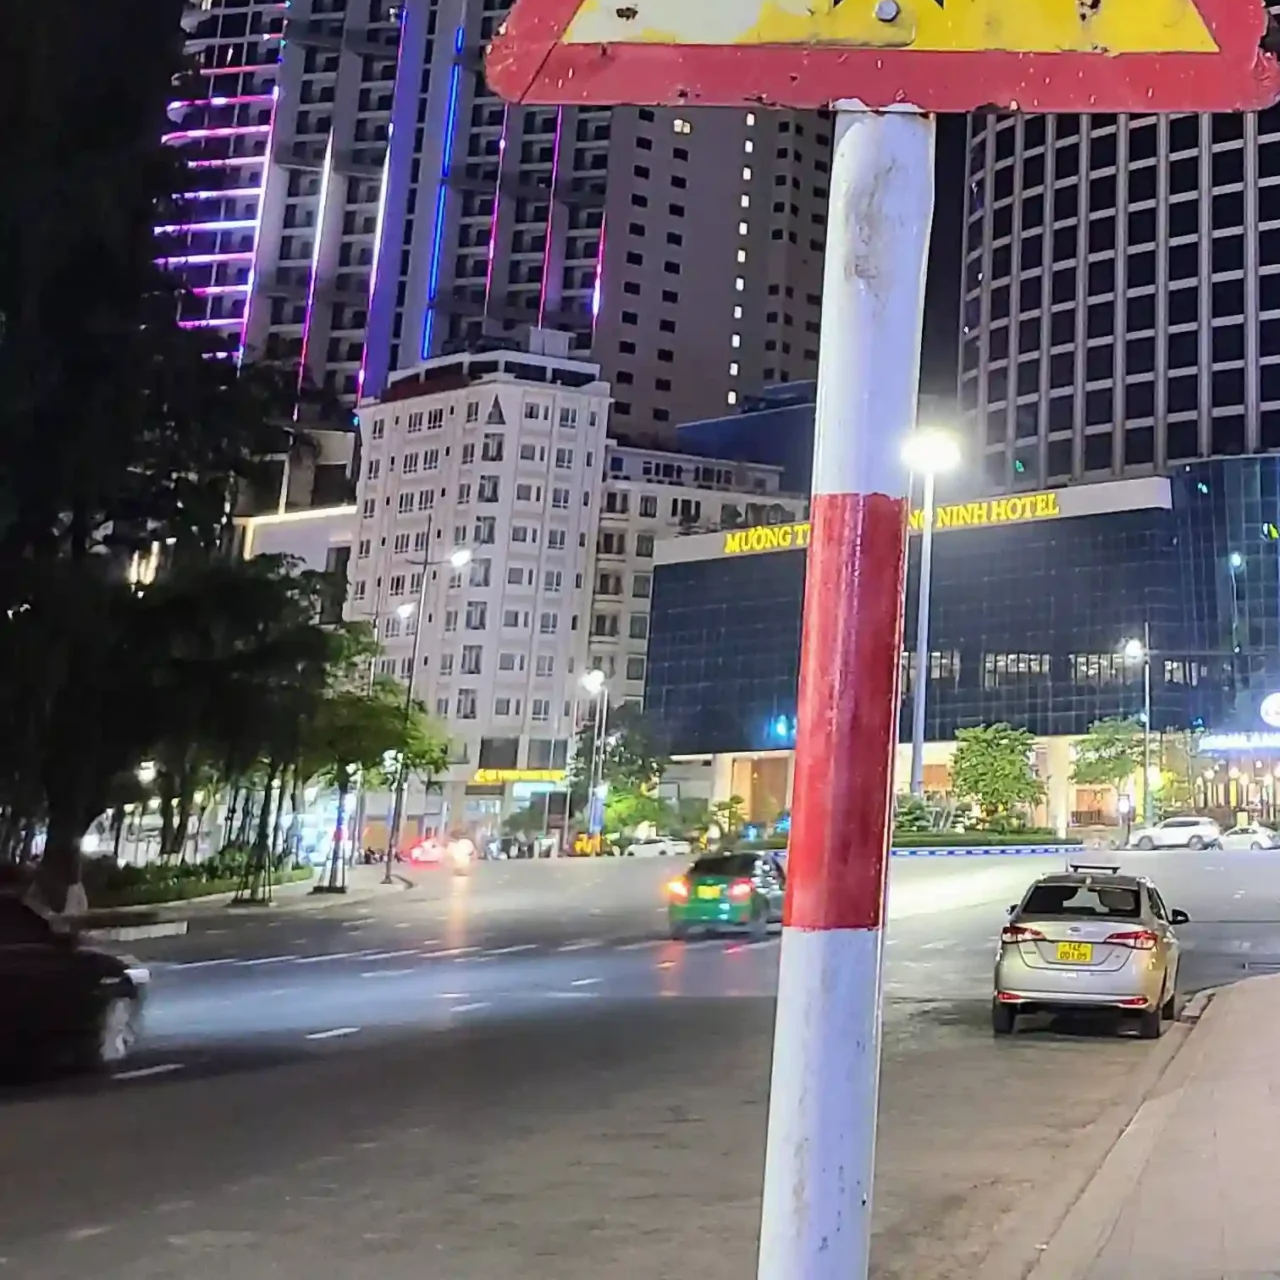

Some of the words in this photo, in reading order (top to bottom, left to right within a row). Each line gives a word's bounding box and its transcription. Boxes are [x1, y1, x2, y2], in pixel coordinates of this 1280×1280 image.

[724, 525, 792, 553] MƯỜNG
[936, 502, 988, 529] NINH
[991, 493, 1060, 521] HOTEL
